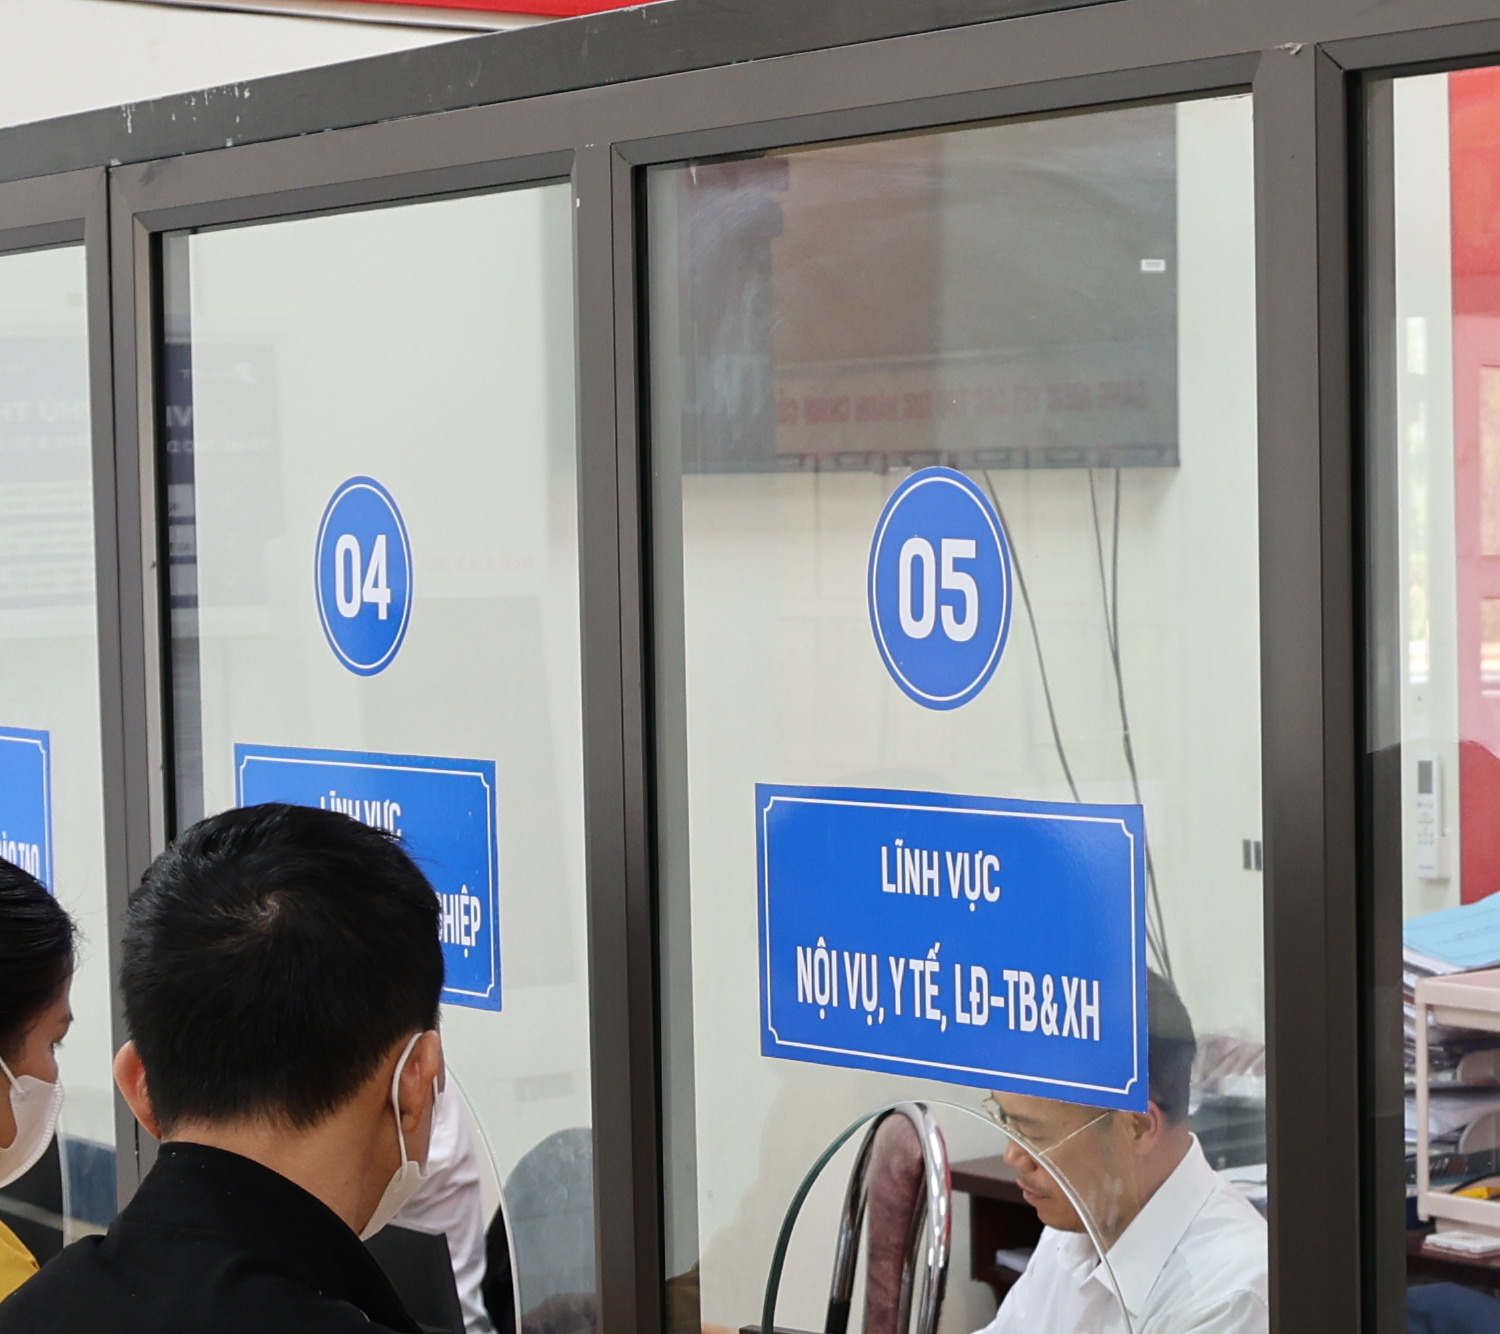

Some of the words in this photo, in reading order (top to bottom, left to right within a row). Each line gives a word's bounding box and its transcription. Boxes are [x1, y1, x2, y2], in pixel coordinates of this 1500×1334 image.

[335, 534, 390, 619] 04
[899, 535, 978, 641] 05
[882, 839, 939, 896] LĨNH
[946, 851, 1000, 911] VỰC
[796, 936, 838, 1020] NỘI
[844, 953, 885, 1026] VỤ,
[889, 955, 908, 1014] Y
[909, 942, 947, 1032] TẾ,
[955, 964, 1100, 1042] LĐ-TB&XH
